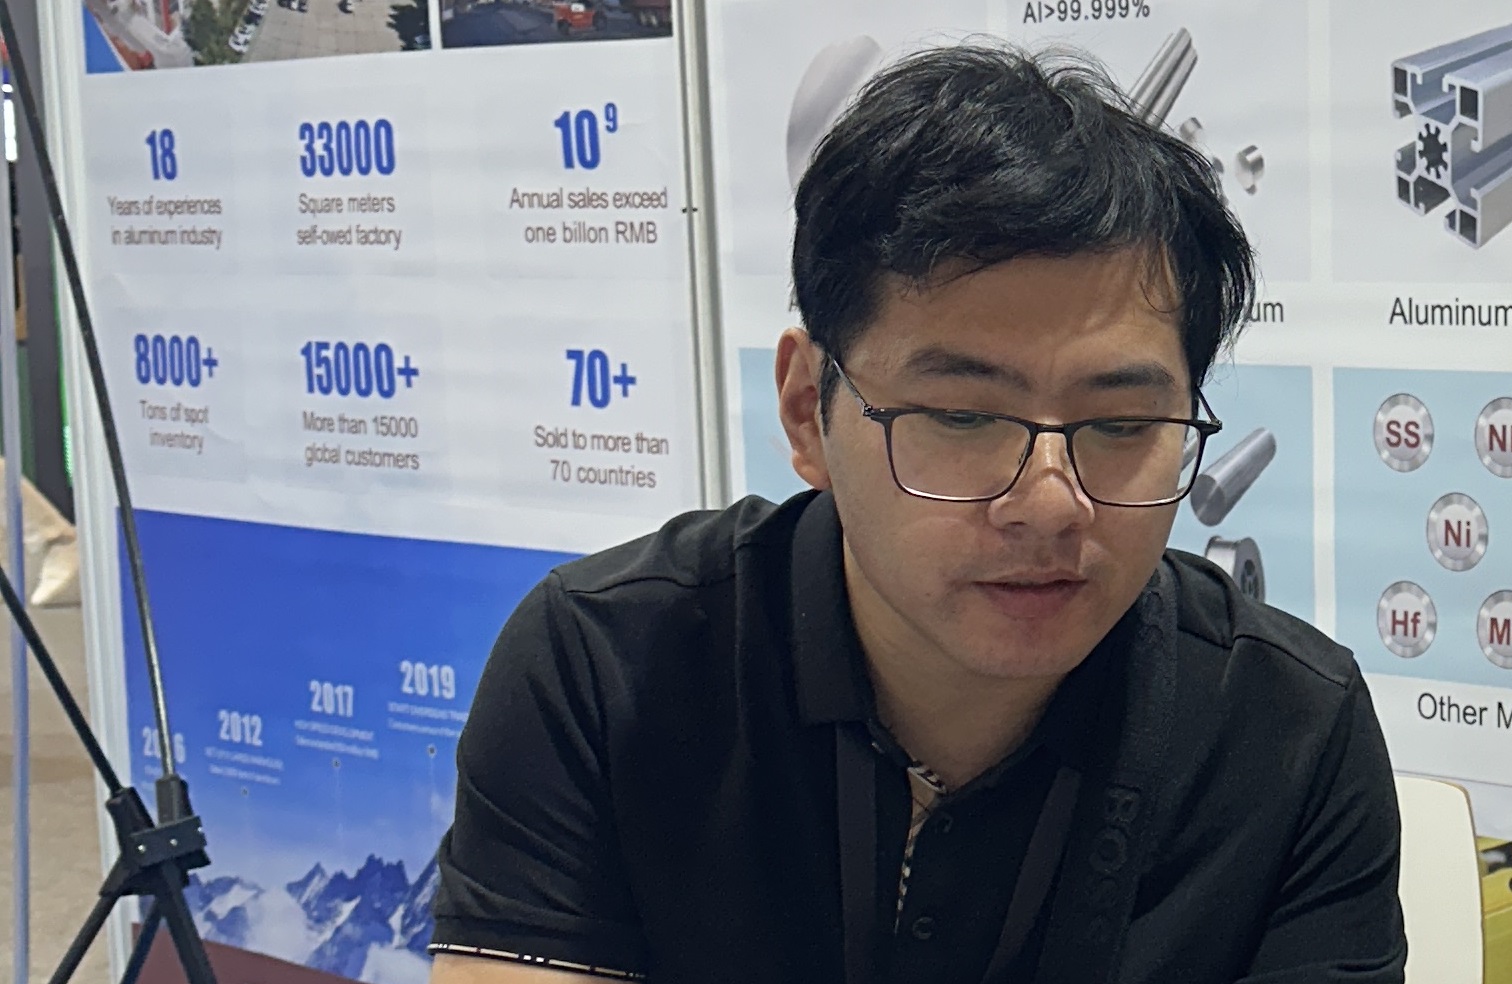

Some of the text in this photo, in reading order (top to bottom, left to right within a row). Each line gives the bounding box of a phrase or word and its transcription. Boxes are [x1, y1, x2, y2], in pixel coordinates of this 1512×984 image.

[146, 128, 177, 180] 18
[298, 118, 396, 178] 33000
[107, 196, 140, 215] Years
[154, 195, 222, 219] experiences
[298, 193, 396, 217] Square meters
[509, 187, 668, 209] Annual sales exceed
[179, 226, 222, 251] industry
[355, 224, 402, 251] factory
[524, 226, 556, 244] one
[615, 221, 658, 244] RMB
[134, 333, 218, 388] 8000+
[300, 341, 420, 399] 15000+
[566, 349, 637, 409] 70+
[140, 400, 209, 428] Tons of spot
[303, 411, 418, 438] More than 15000
[150, 428, 204, 455] inventory
[534, 425, 669, 455] Sold to more than
[1385, 421, 1421, 449] SS
[304, 444, 420, 470] global customers
[550, 459, 657, 488] 70 countries
[1443, 519, 1471, 548] Ni
[1391, 610, 1422, 638] Hf
[400, 659, 456, 699] 2019
[310, 680, 354, 718] 2017
[1417, 693, 1488, 726] Other
[218, 709, 263, 747] 2012
